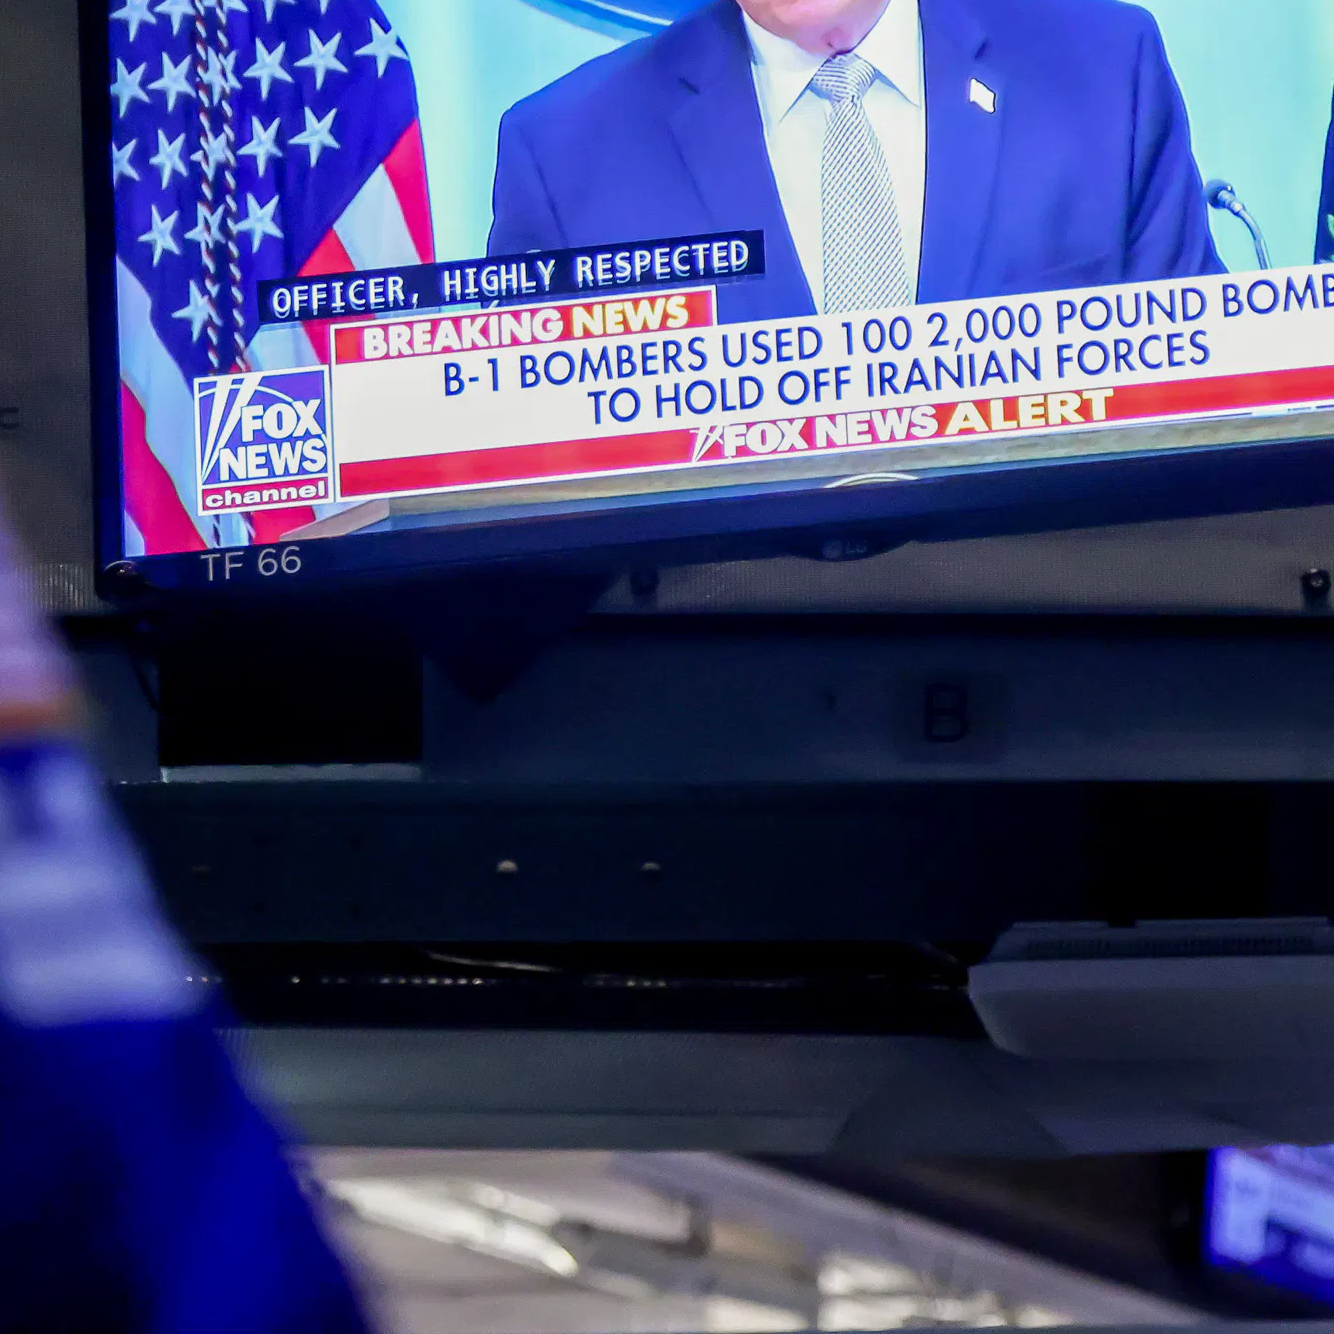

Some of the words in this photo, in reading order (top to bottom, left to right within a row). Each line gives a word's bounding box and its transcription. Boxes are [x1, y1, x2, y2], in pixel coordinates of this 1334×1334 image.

[272, 275, 419, 314] OFFICER,
[444, 260, 556, 296] HIGHLY
[576, 240, 749, 284] RESPECTED
[363, 308, 564, 359] BREAKING
[571, 295, 689, 338] NEWS
[443, 357, 501, 397] B-1
[519, 335, 708, 389] BOMBERS
[722, 326, 823, 368] USED
[843, 316, 913, 356] 100
[926, 302, 1042, 351] 2,000
[1056, 286, 1208, 334] POUND
[587, 387, 642, 425] TO
[655, 375, 765, 419] HOLD
[777, 365, 852, 407] OFF
[866, 347, 1042, 397] IRANIAN
[1056, 329, 1211, 378] FORCES
[240, 398, 324, 442] FOX
[722, 418, 808, 459] FOX
[813, 406, 940, 449] NEWS
[943, 387, 1115, 437] ALERT
[219, 438, 327, 482] NEWS
[205, 480, 327, 508] channel
[200, 551, 245, 582] TF
[257, 545, 303, 577] 66
